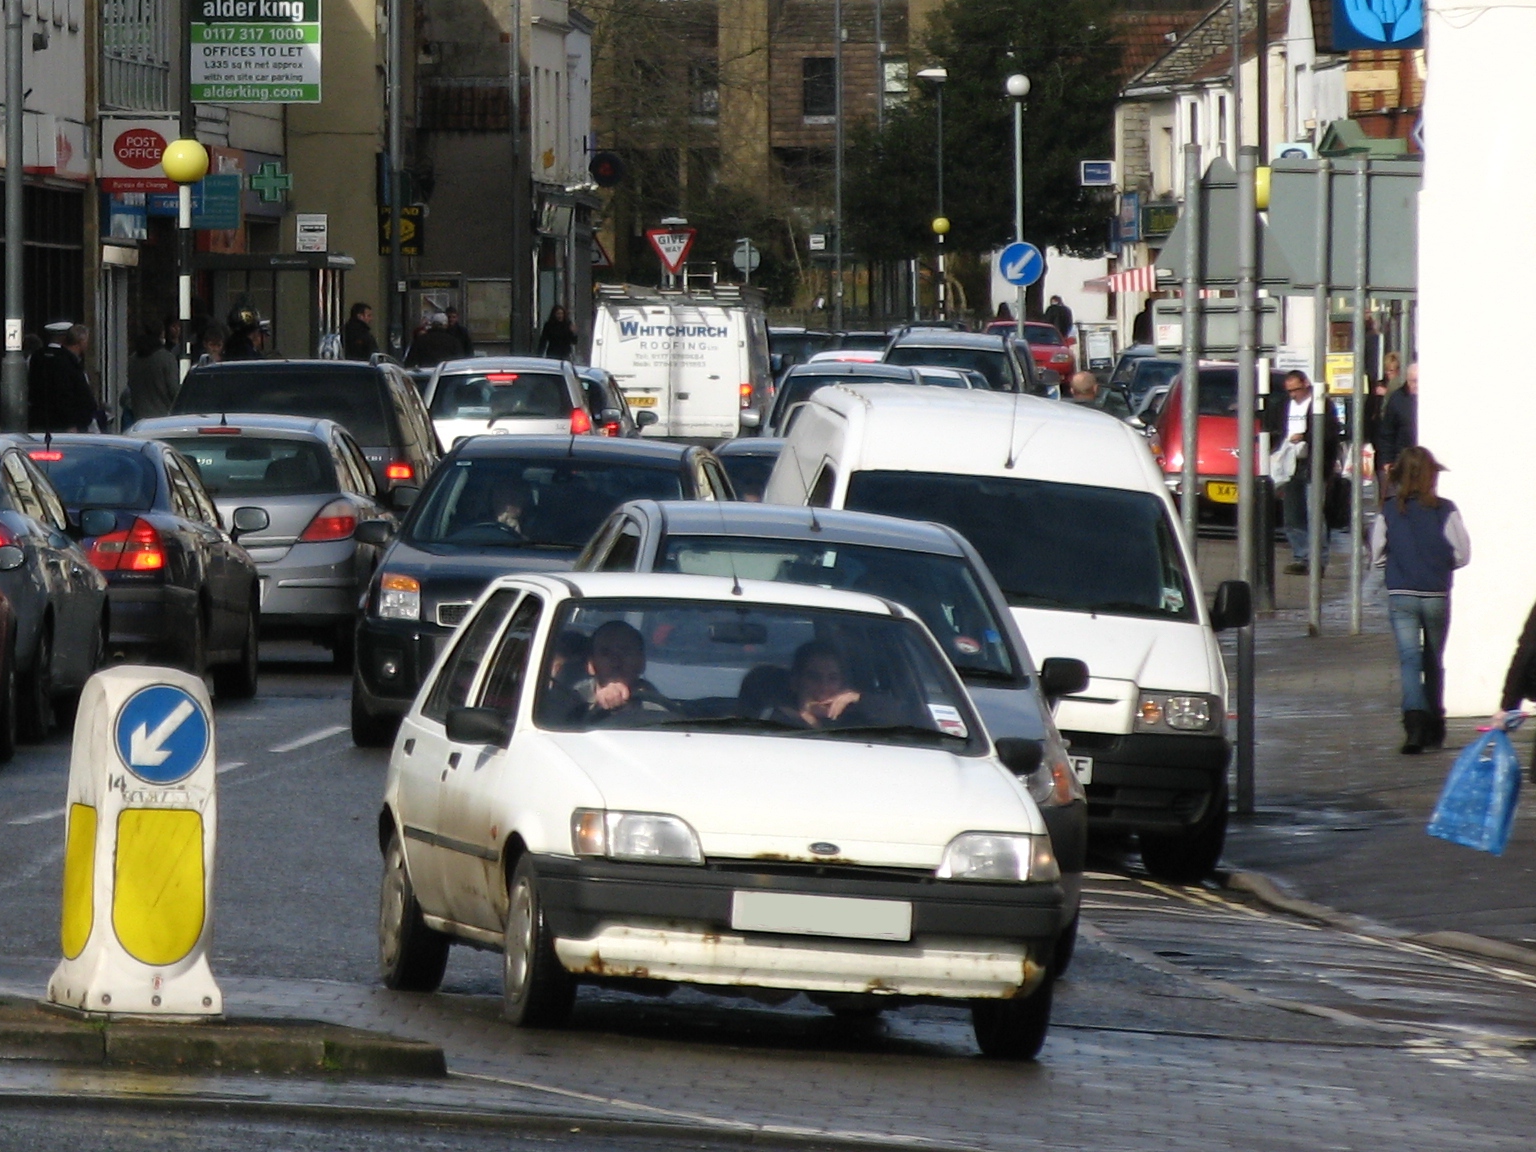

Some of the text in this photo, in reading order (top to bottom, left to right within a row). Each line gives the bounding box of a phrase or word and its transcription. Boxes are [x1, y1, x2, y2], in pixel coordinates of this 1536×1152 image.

[203, 28, 304, 40] 0117 317 1000
[203, 47, 303, 57] OFFICES TO LET
[272, 62, 303, 70] approx
[271, 74, 303, 83] parking
[203, 85, 304, 100] alderking.com
[126, 136, 158, 147] POST
[118, 148, 161, 159] OFFICE
[658, 235, 685, 245] GIVE
[619, 321, 728, 338] WHITCHURCH
[640, 341, 707, 351] ROOFING
[108, 773, 126, 793] 14
